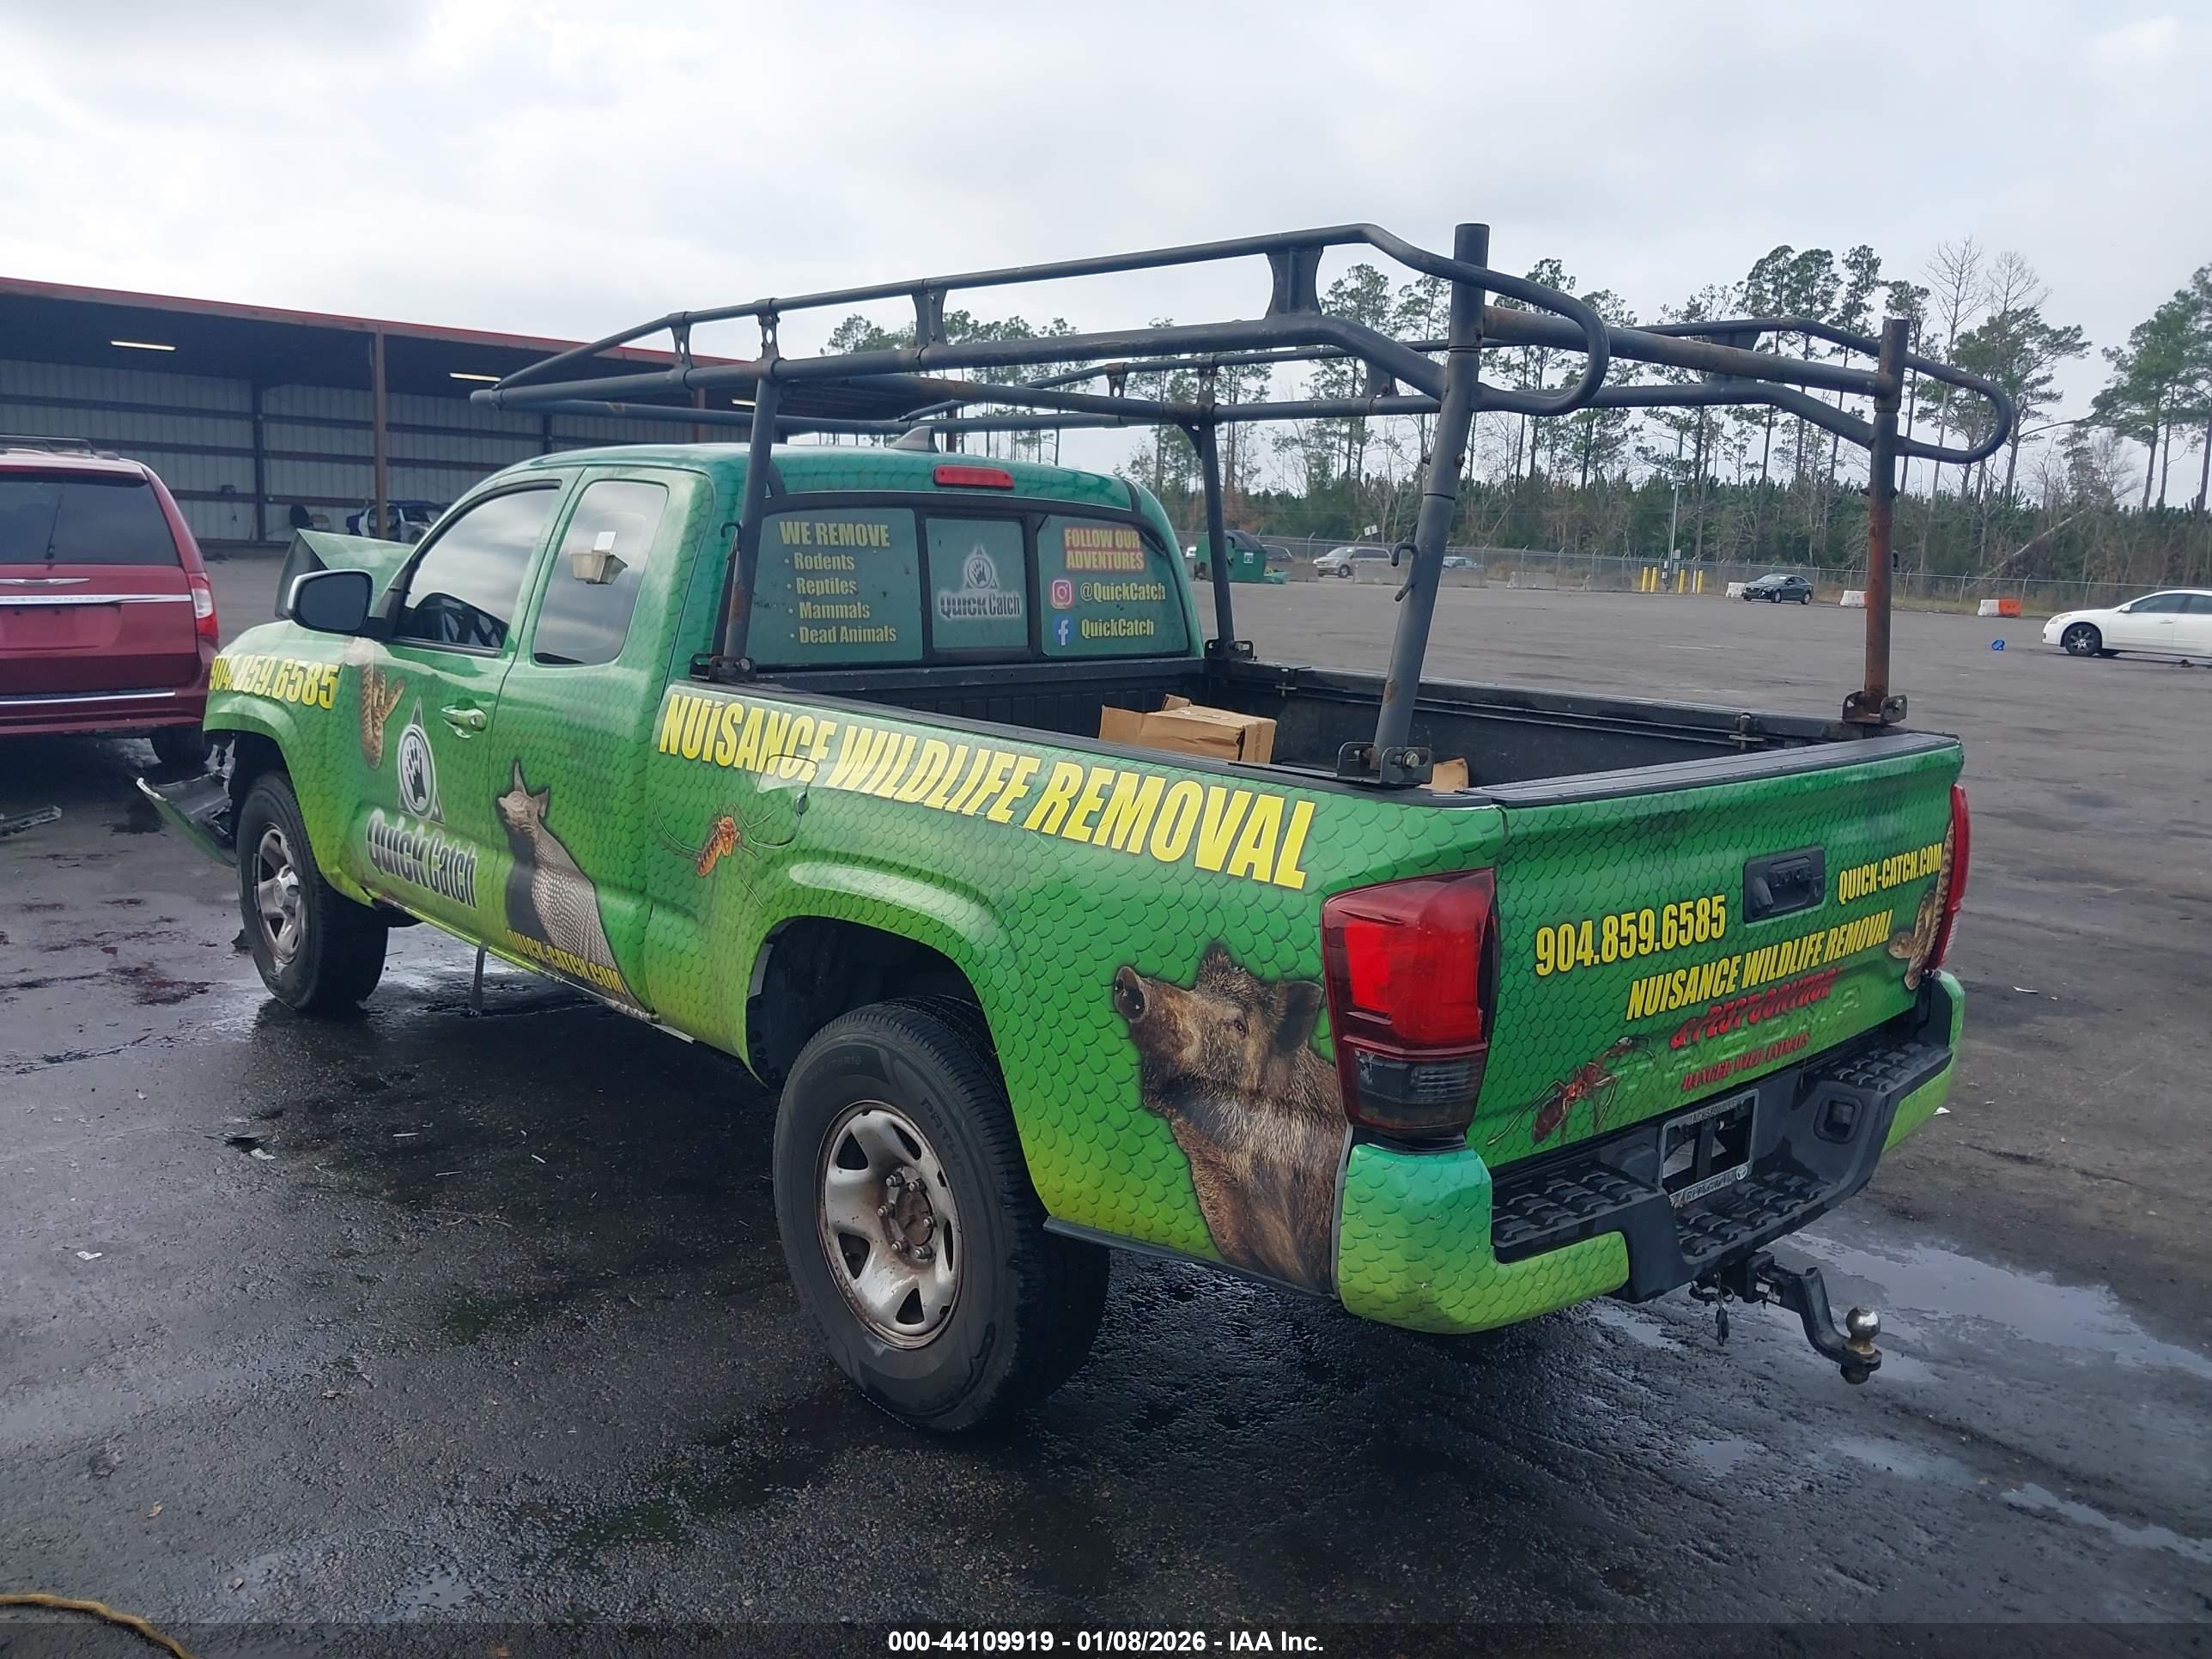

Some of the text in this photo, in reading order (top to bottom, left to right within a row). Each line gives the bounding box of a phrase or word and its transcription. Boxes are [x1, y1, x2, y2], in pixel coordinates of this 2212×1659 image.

[780, 521, 890, 547] WE REMOVE
[1065, 528, 1141, 549] FOLLOW OUR
[794, 552, 855, 570] Rodents
[1066, 550, 1145, 570] ADVENTURES
[796, 577, 858, 596] Reptiles
[1080, 582, 1167, 603] @QuickCatch
[799, 601, 871, 618] Mammals
[988, 592, 1021, 616] Catch
[799, 625, 897, 644] Dead Animals
[1081, 617, 1155, 639] QuickCatch
[209, 655, 340, 710] 904.859.6585
[659, 694, 1316, 890] NUISANCE WILDLIFE REMOVAL
[428, 828, 478, 910] Catch
[1838, 842, 1943, 905] QUICK-CATCH.COM
[1535, 895, 1727, 976] 904.859.6585
[507, 928, 626, 994] QUICK-CATCH.COM
[1626, 908, 1894, 1020] NUISANCE WILDLIFE REMOVAL
